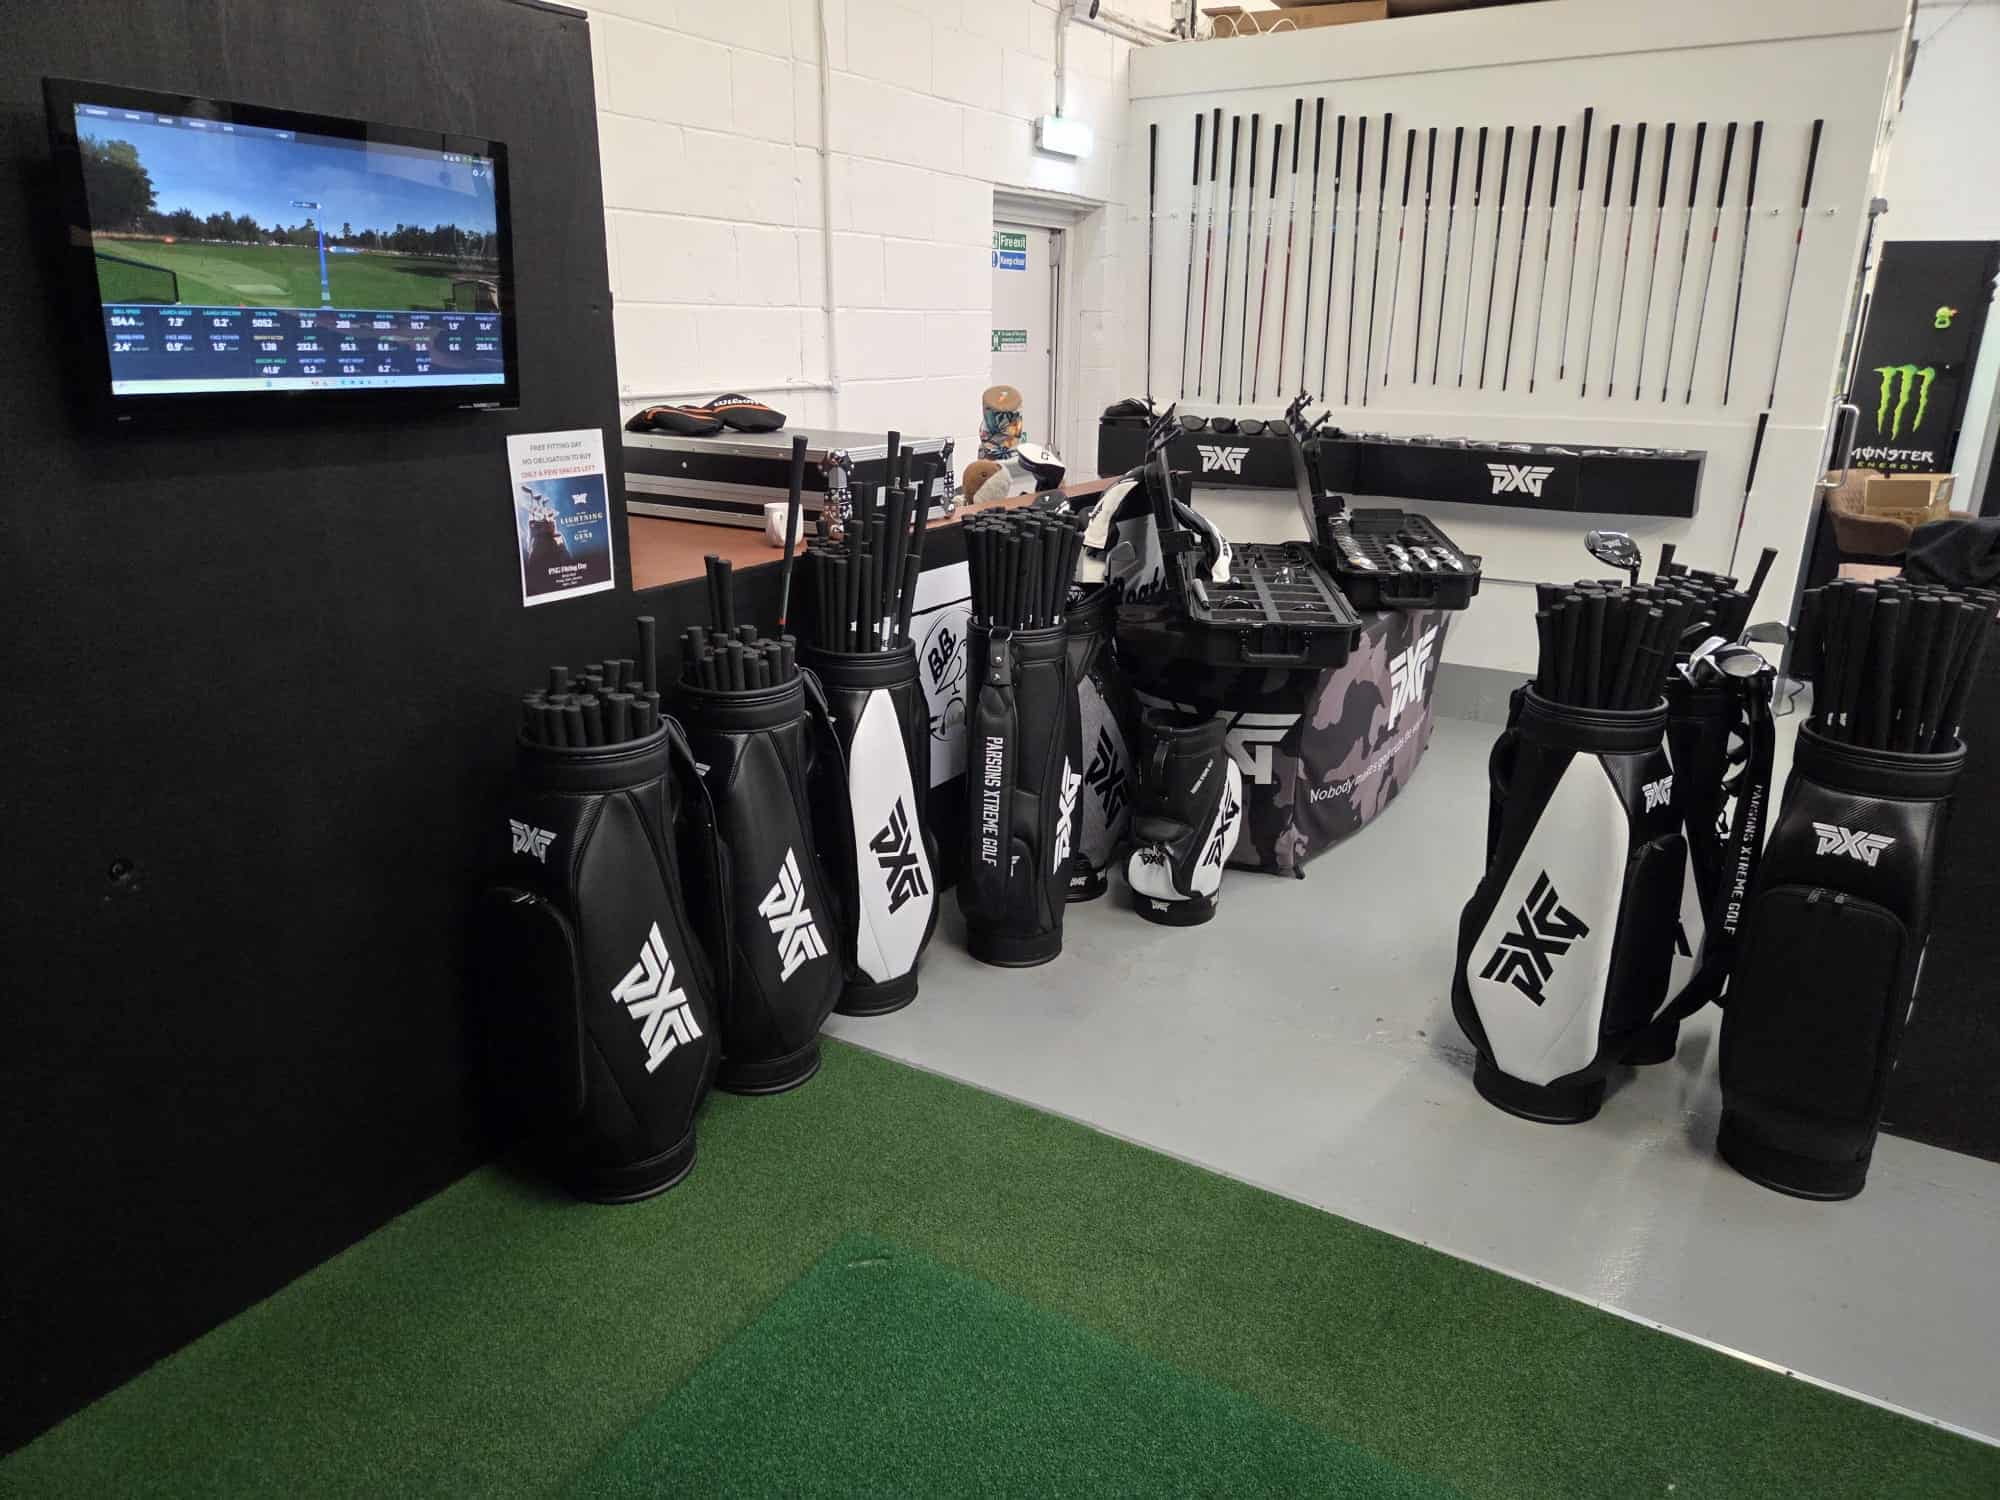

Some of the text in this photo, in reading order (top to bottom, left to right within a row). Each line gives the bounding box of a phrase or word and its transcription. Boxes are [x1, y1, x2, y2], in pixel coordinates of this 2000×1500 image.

[1000, 235, 1012, 248] Fire
[1197, 445, 1245, 474] PXG
[1851, 446, 1934, 463] MONSTER
[1857, 461, 1919, 470] ENERGY
[1487, 464, 1554, 498] PXG
[1388, 625, 1439, 731] PXG
[982, 736, 1003, 867] PARSONS XTREME GOLF
[1310, 779, 1354, 803] Nobody
[1642, 775, 1673, 814] PXG
[508, 818, 558, 864] PXG
[869, 795, 928, 914] PXG
[1724, 784, 1763, 936] PARSONS XTREME GOLF
[1812, 822, 1896, 867] PXG
[758, 847, 828, 983] PXG
[1478, 870, 1590, 1007] PXG
[610, 921, 704, 1074] PXG
